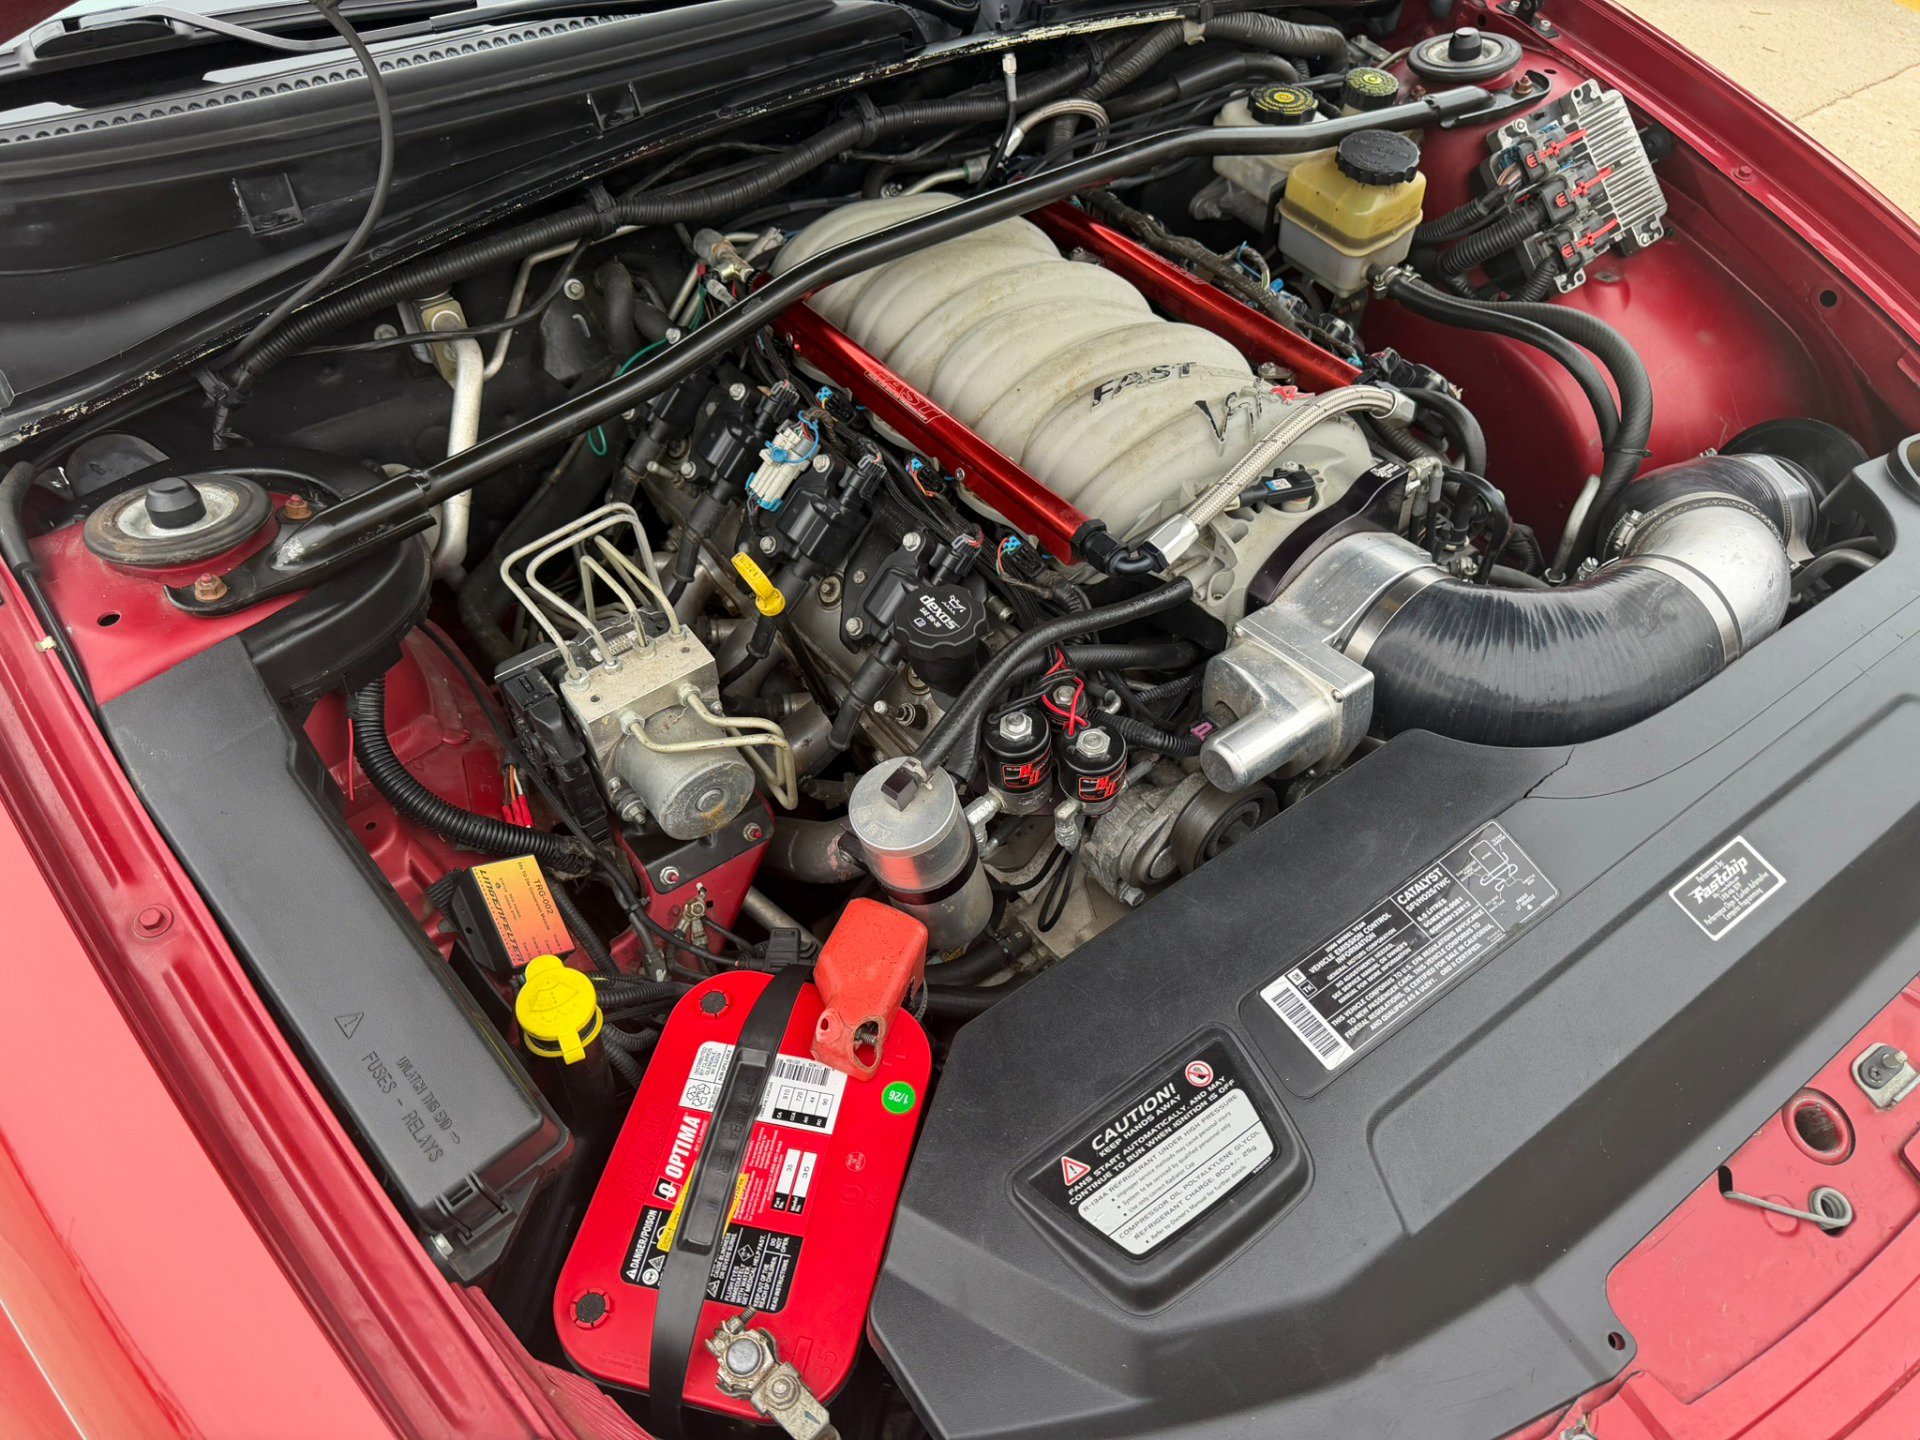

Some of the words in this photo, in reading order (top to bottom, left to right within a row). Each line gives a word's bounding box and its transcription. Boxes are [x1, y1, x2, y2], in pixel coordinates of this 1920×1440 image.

[1091, 362, 1198, 410] FAST
[919, 595, 960, 629] dexos
[533, 878, 554, 914] TRG-002
[1395, 867, 1444, 905] CATALYST
[1687, 857, 1748, 904] Fastchip
[479, 869, 524, 963] LINGENFELTER
[1415, 911, 1428, 922] 6.0
[1425, 897, 1447, 915] LITRES
[1308, 952, 1335, 974] VEHICLE
[1333, 931, 1364, 956] EMISSION
[1362, 911, 1392, 934] CONTROL
[1334, 931, 1377, 964] INFORMATION
[1336, 929, 1354, 944] MODEL
[1352, 920, 1366, 933] YEAR
[1326, 963, 1348, 981] GENERAL
[1346, 949, 1367, 966] MOTORS
[1365, 927, 1397, 952] CORPORATION
[1330, 1013, 1346, 1027] THIS
[1343, 998, 1367, 1017] VEHICLE
[1364, 976, 1395, 1001] CONFORMS
[1392, 970, 1403, 980] TO
[1400, 962, 1414, 974] U.S.
[1410, 954, 1423, 965] EPA
[1420, 929, 1456, 958] REGULATIONS
[1453, 908, 1485, 933] APPLICABLE
[1334, 979, 1344, 988] NO
[1342, 956, 1376, 982] ADJUSTMENTS
[1346, 1016, 1357, 1026] TO
[1354, 1006, 1369, 1019] NEW
[1366, 983, 1400, 1010] PASSENGER
[1396, 972, 1415, 987] CARS.
[1412, 962, 1427, 975] THIS
[1423, 947, 1447, 966] VEHICLE
[1444, 926, 1474, 950] CONFORMS
[1471, 921, 1481, 930] TO
[1302, 983, 1314, 993] TK
[1330, 989, 1343, 1000] SEE
[1340, 975, 1362, 992] SERVICE
[1359, 961, 1381, 978] MANUAL
[1378, 956, 1388, 965] OR
[1337, 986, 1359, 1004] MANUAL
[1356, 979, 1368, 990] FOR
[1366, 969, 1382, 983] MORE
[1380, 947, 1412, 972] INFORMATION
[1343, 1017, 1370, 1038] FEDERAL
[1402, 985, 1411, 993] IS
[1408, 966, 1436, 988] CERTIFIED
[1433, 958, 1447, 969] FOR
[1444, 948, 1459, 961] SALE
[1368, 1018, 1383, 1030] AND
[1380, 998, 1409, 1021] QUALIFIES
[1406, 992, 1416, 1002] AS
[1439, 964, 1453, 976] OBD
[362, 1051, 397, 1093] FUSES
[402, 1109, 444, 1162] RELAYS
[422, 1091, 441, 1113] THIS
[434, 1109, 453, 1131] END
[781, 1088, 791, 1099] 910
[795, 1091, 803, 1101] 720
[1066, 1175, 1094, 1196] FANS
[1092, 1153, 1123, 1176] START
[1188, 1089, 1207, 1105] AND
[1206, 1075, 1226, 1092] MAY
[1092, 1082, 1176, 1151] CAUTION!
[1098, 1137, 1124, 1157] KEEP
[1122, 1113, 1155, 1139] HANDS
[1154, 1092, 1182, 1116] AWAY
[665, 1115, 702, 1179] OPTIMA
[1067, 1171, 1113, 1205] CONTINUE
[1112, 1160, 1127, 1172] TO
[1125, 1146, 1146, 1162] RUN
[1145, 1126, 1172, 1148] WHEN
[1171, 1098, 1208, 1128] IGNITION
[1207, 1091, 1218, 1102] IS
[1217, 1077, 1236, 1094] OFF
[1081, 1191, 1109, 1212] R-134A
[1107, 1154, 1157, 1192] REFRIGERANT
[1157, 1134, 1183, 1155] UNDER
[1182, 1121, 1200, 1136] HIGH
[1200, 1093, 1237, 1123] PRESSURE
[785, 1163, 793, 1172] 35
[801, 1166, 811, 1178] 35
[1117, 1199, 1169, 1238] COMPRESSOR
[1182, 1149, 1234, 1190] POLYALKYLENE
[1233, 1128, 1260, 1151] GLYCOL
[789, 1196, 799, 1211] Model
[1132, 1199, 1185, 1240] REFRIGERANT
[631, 1209, 657, 1268] DANGER/POISON
[750, 1250, 761, 1265] HELP
[755, 1234, 767, 1250] FAST.
[769, 1237, 777, 1246] DO
[774, 1237, 783, 1248] NOT
[722, 1281, 735, 1300] FLUSH
[729, 1265, 740, 1281] EYES
[727, 1263, 748, 1302] IMMEDIATELY
[735, 1287, 746, 1303] WITH
[740, 1292, 750, 1304] GET
[743, 1266, 758, 1291] MEDICAL
